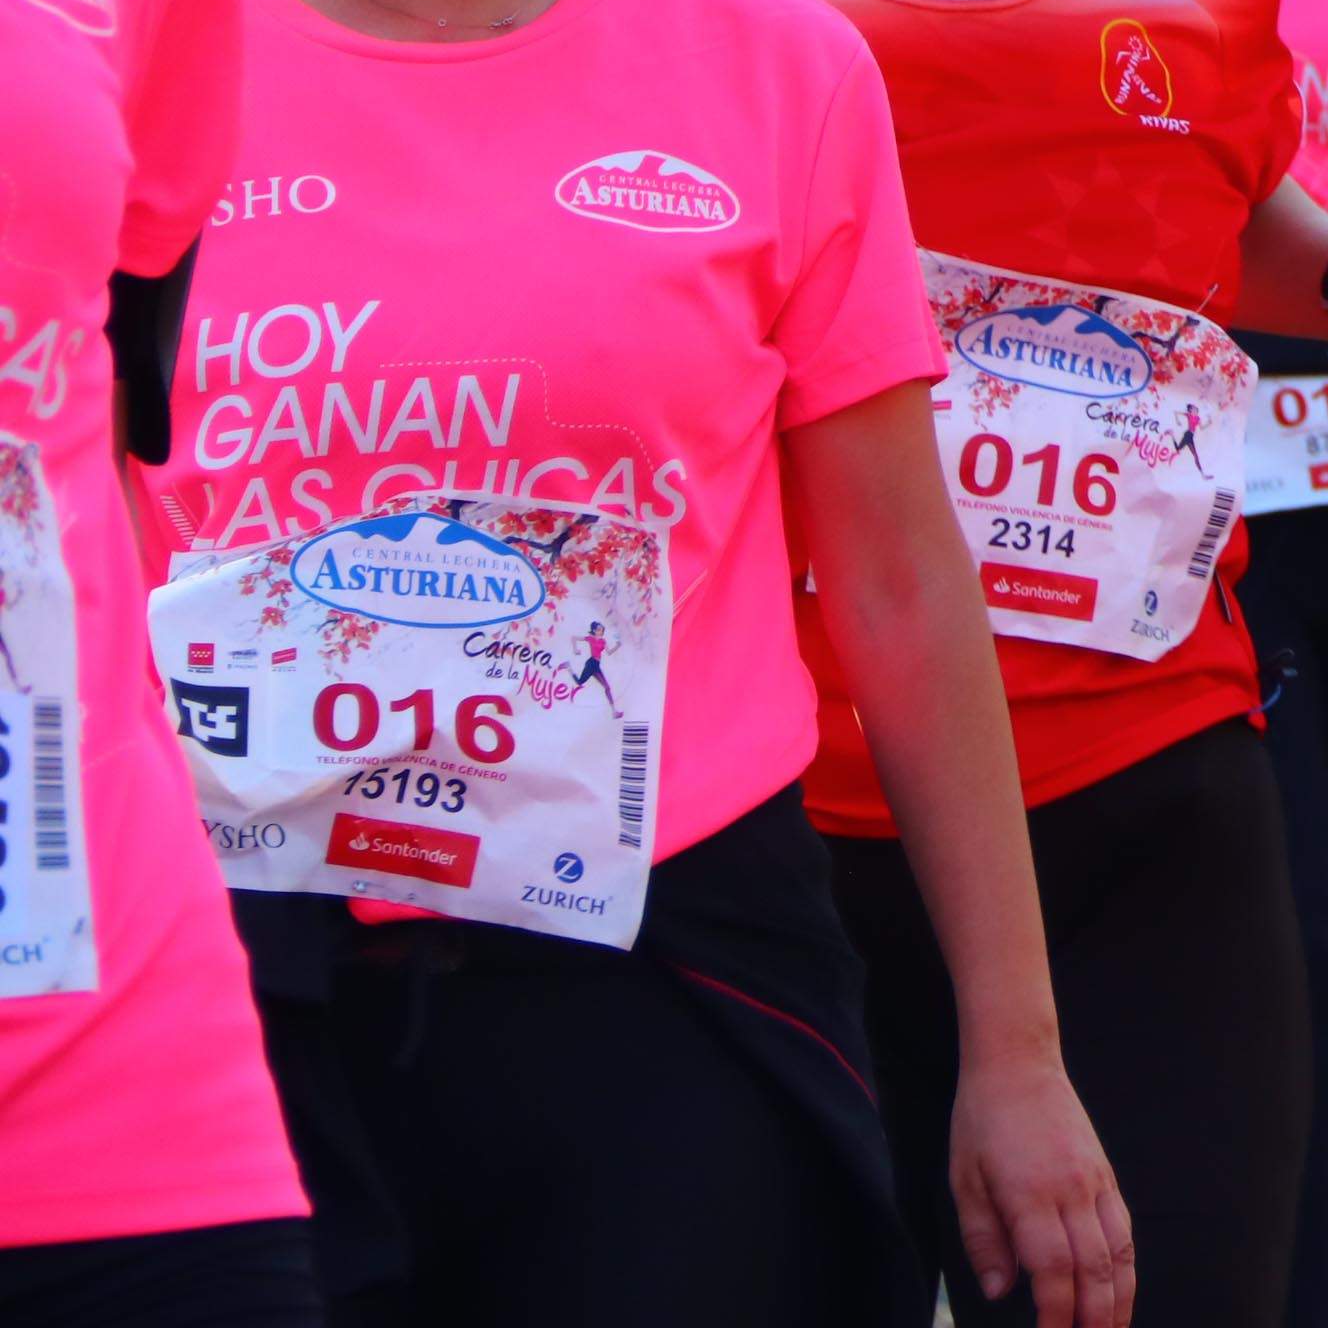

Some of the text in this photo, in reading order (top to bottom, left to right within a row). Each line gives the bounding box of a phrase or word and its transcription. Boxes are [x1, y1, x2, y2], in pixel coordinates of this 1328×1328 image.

[1139, 114, 1190, 134] RIVAS
[570, 176, 728, 221] ASTURIANA
[196, 301, 381, 392] HOY
[967, 323, 1133, 389] ASTURIANA
[194, 373, 521, 470] GANAN
[1086, 402, 1160, 433] Carrera
[1104, 427, 1179, 468] de la Mujer
[959, 433, 1120, 517] 016
[988, 518, 1075, 558] 2314
[310, 548, 527, 607] ASTURIANA
[352, 547, 522, 573] CENTRAL LECHERA
[1012, 581, 1081, 605] Santander
[462, 631, 553, 667] Carrera
[485, 664, 585, 709] de la Mujer
[313, 682, 516, 764] 016
[343, 767, 468, 814] 15193
[371, 836, 458, 867] Santander
[521, 884, 605, 916] ZURICH
